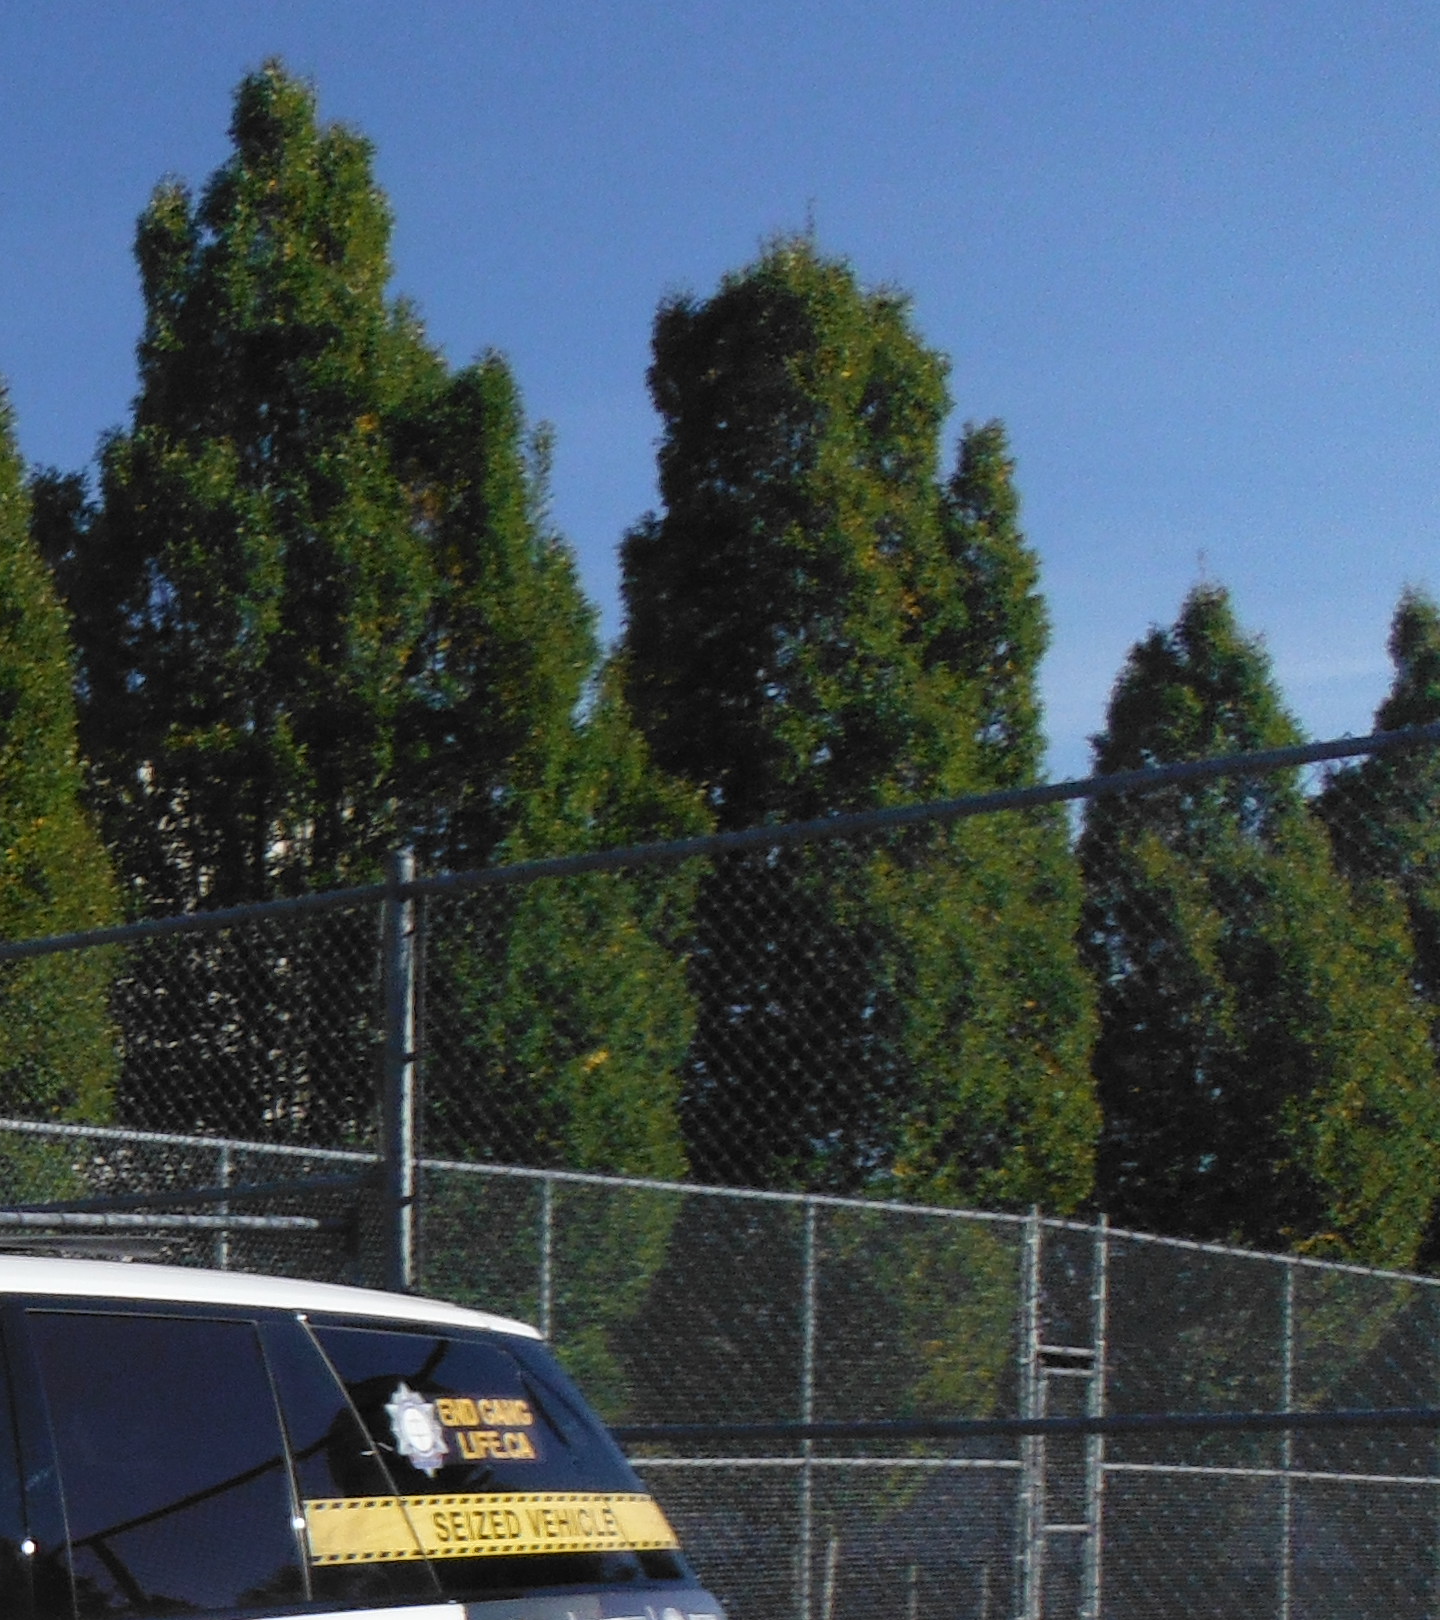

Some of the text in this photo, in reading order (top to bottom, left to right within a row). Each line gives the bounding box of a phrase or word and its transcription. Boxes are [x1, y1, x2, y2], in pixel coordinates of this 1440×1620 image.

[436, 1398, 481, 1426] END
[433, 1506, 618, 1542] SEIZED VEHICLE
